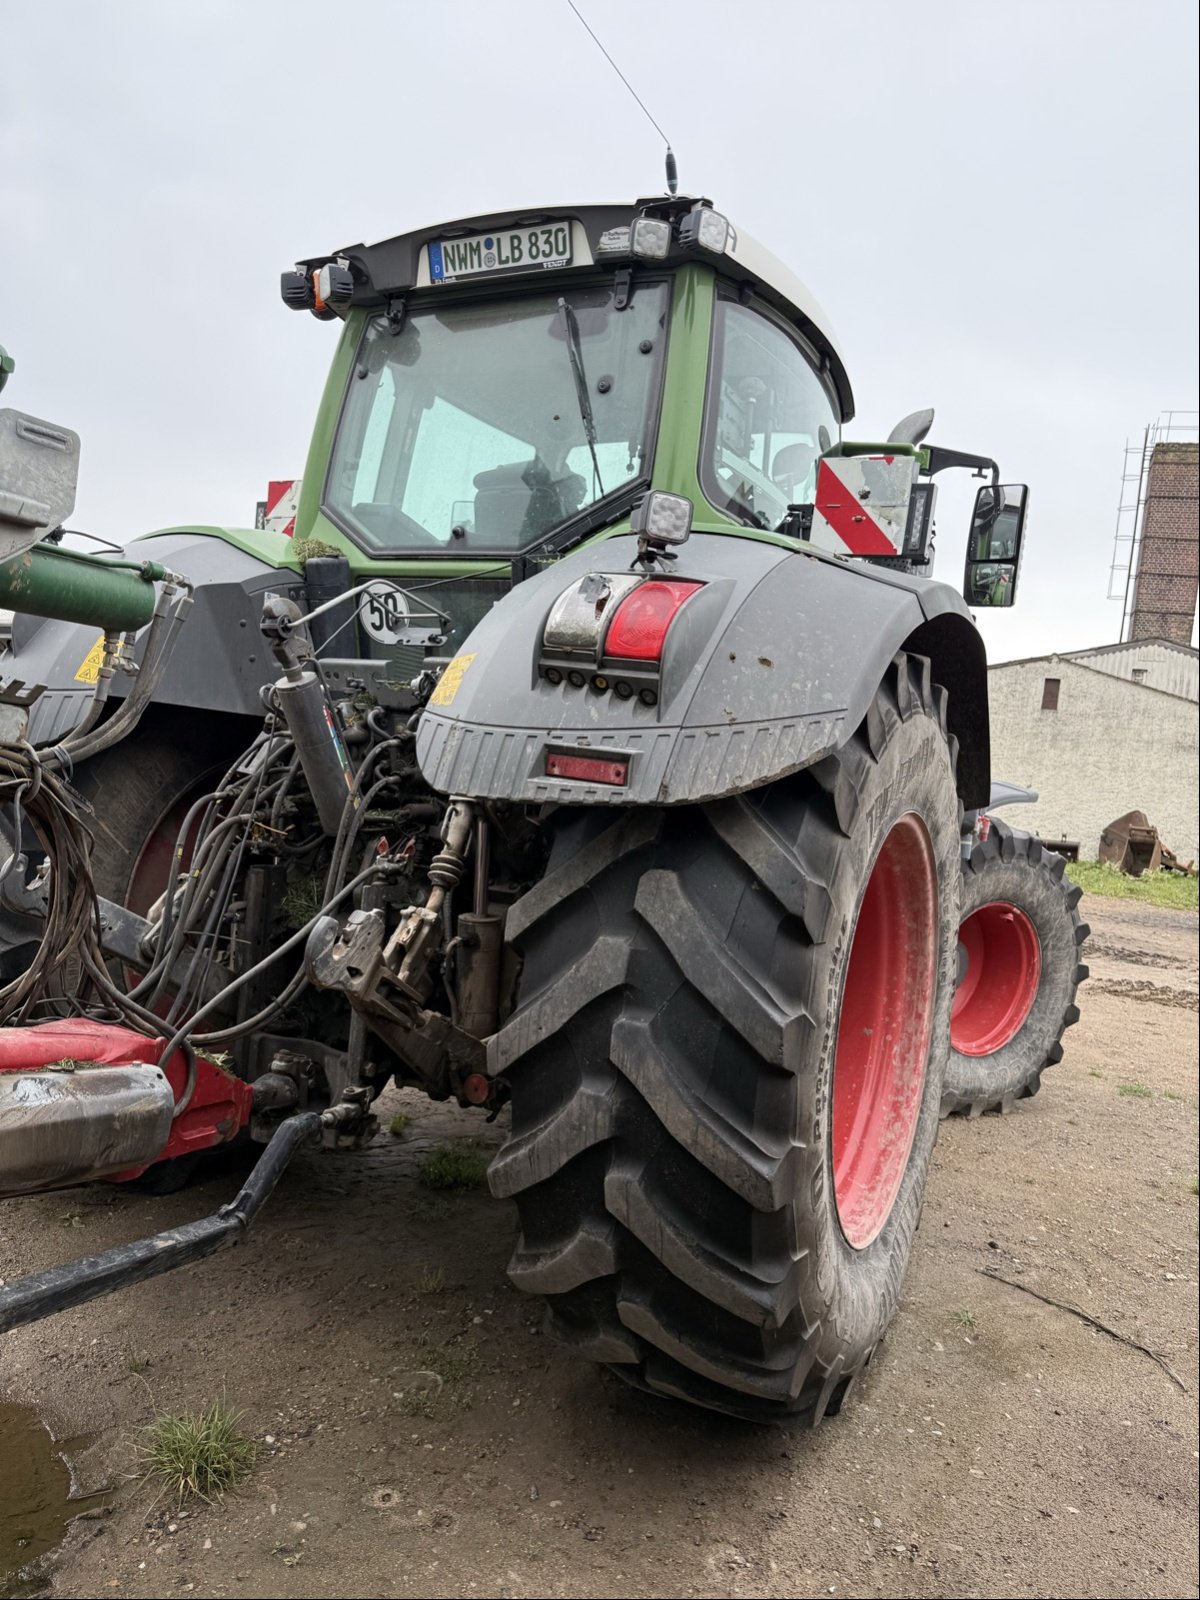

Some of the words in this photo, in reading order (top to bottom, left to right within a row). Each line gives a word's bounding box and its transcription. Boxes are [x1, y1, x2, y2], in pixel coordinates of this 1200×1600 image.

[443, 240, 482, 273] NWM
[496, 234, 523, 266] LB
[528, 227, 567, 260] 830
[434, 264, 441, 274] D
[543, 259, 568, 269] FENDT
[369, 591, 400, 632] 50
